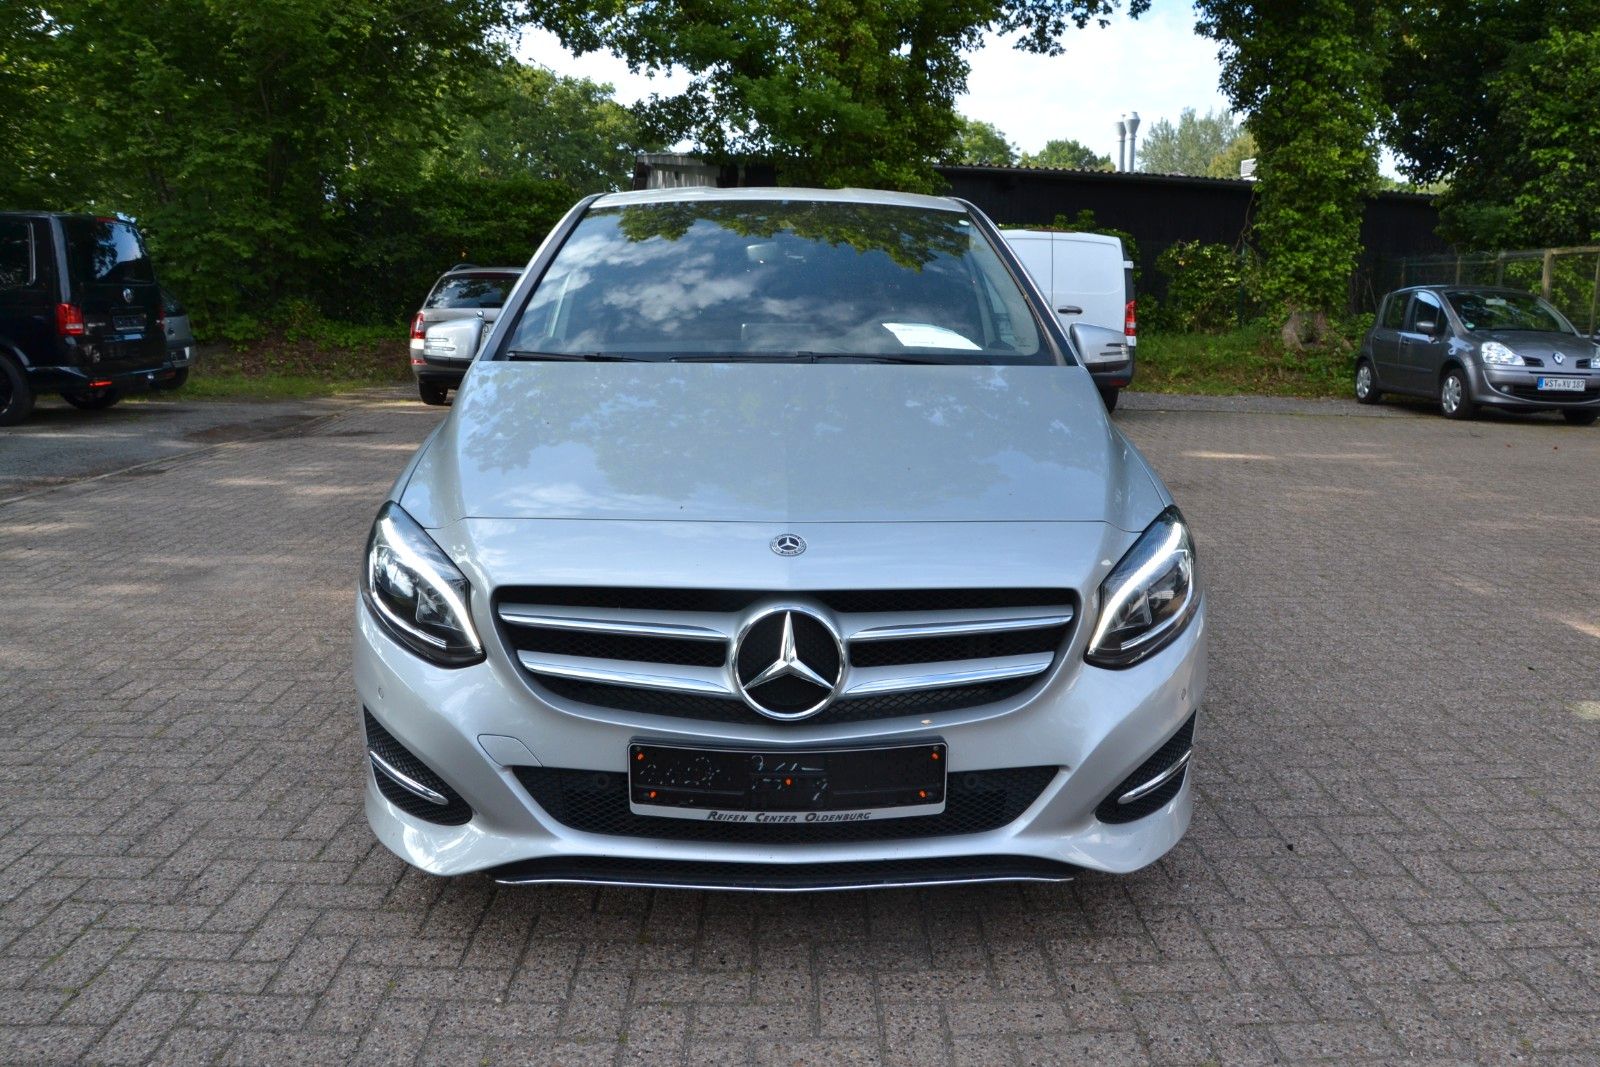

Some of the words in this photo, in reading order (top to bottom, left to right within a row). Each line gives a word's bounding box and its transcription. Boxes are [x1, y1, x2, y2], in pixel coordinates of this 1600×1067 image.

[707, 810, 748, 821] REIFEN
[755, 812, 798, 823] CENTER
[805, 811, 872, 822] OLDENBURG
